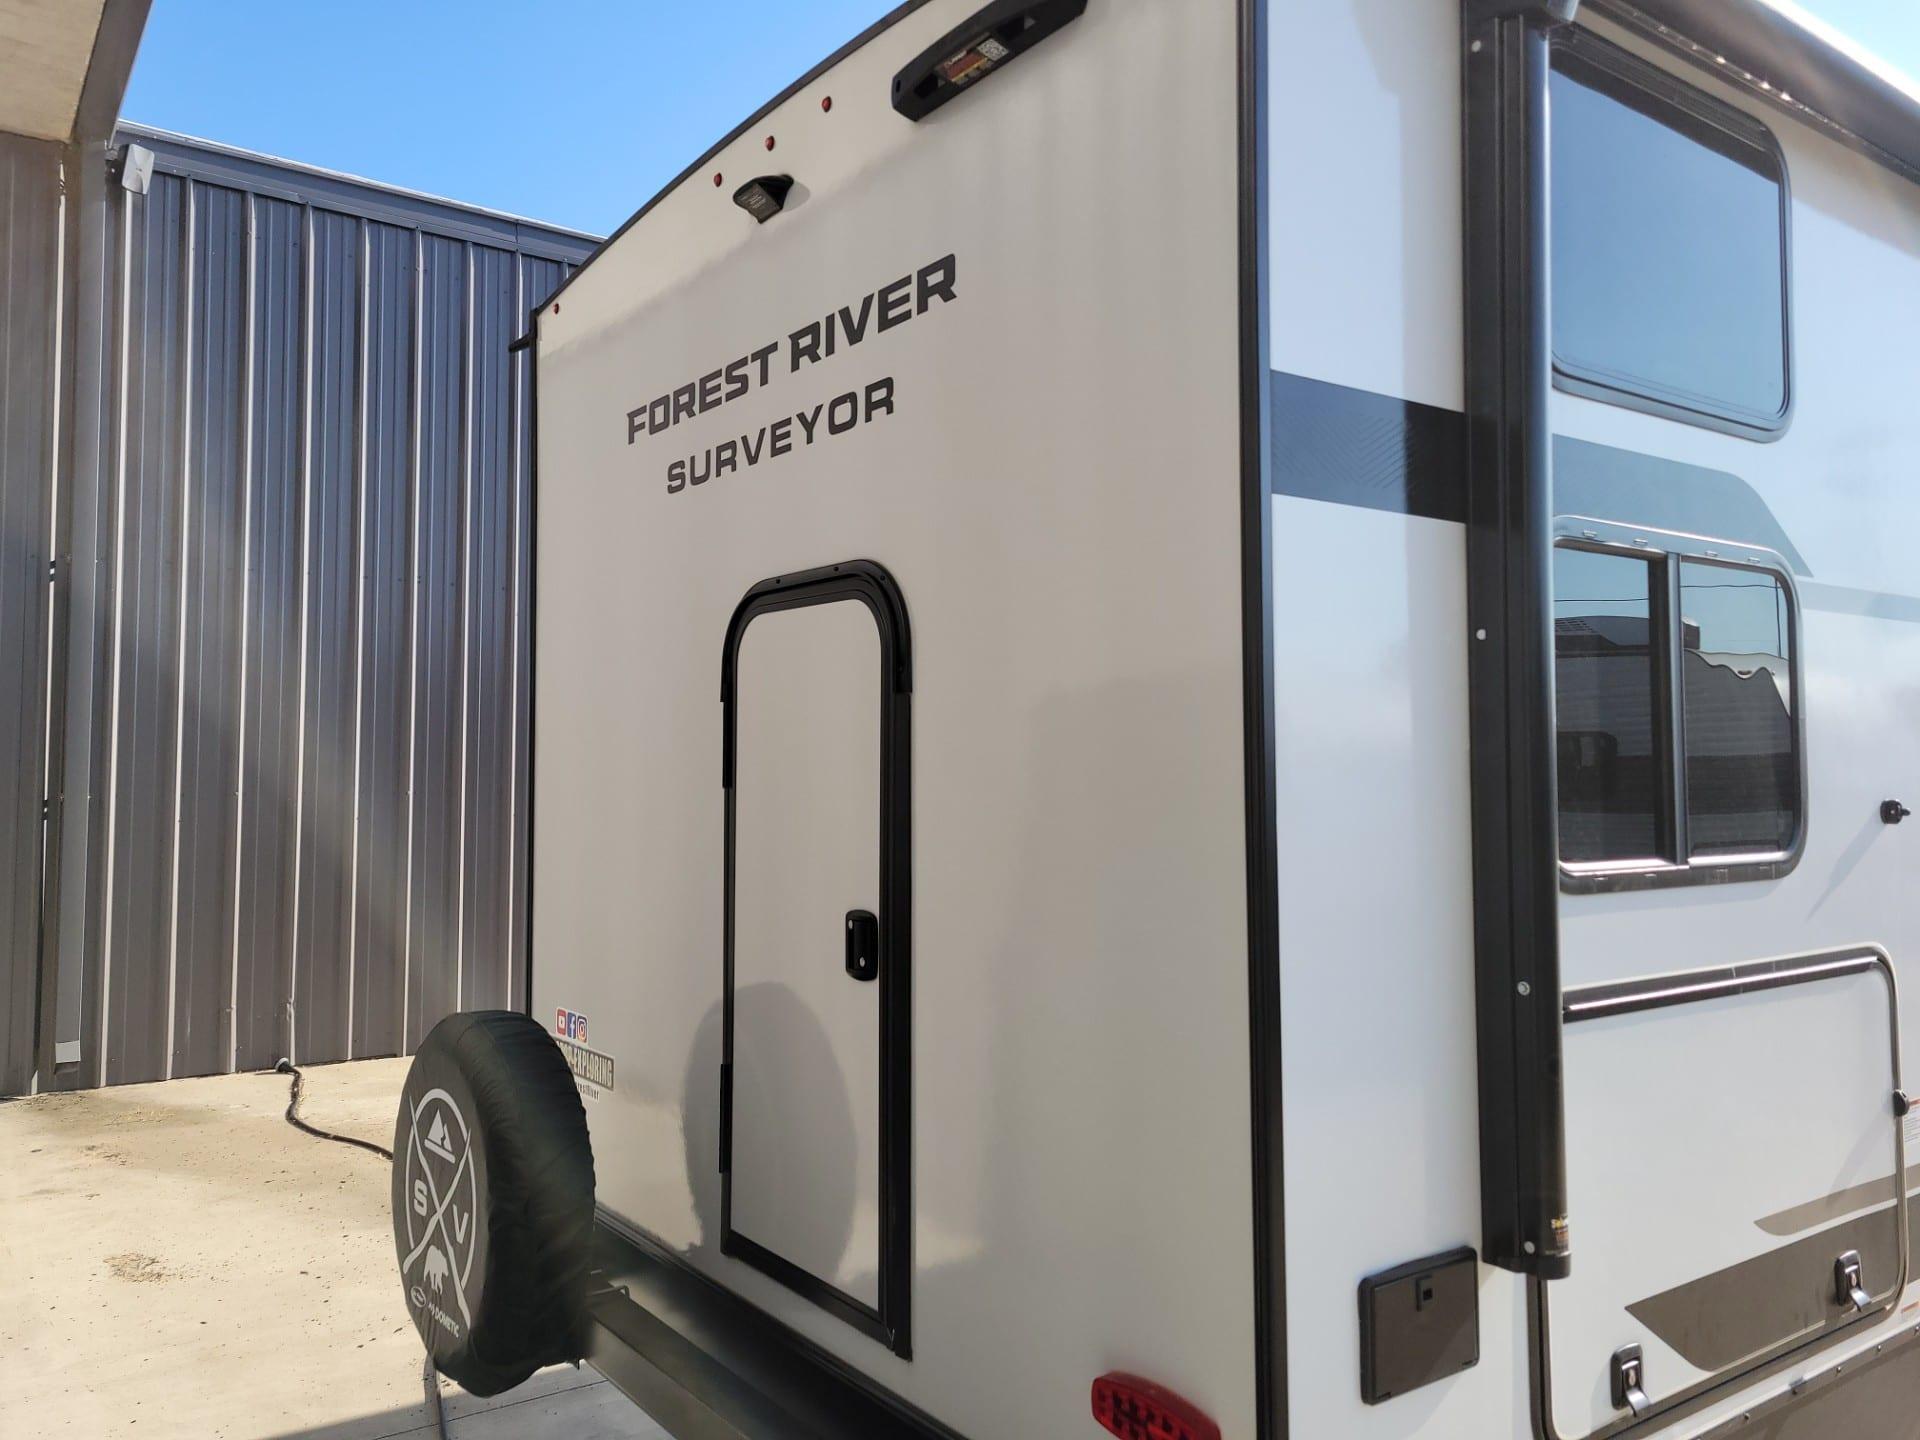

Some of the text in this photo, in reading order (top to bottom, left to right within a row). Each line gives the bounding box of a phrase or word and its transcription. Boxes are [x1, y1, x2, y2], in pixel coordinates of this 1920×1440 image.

[627, 253, 957, 445] FOREST RIVER
[667, 376, 894, 494] SURVEYOR
[413, 1179, 469, 1244] S V
